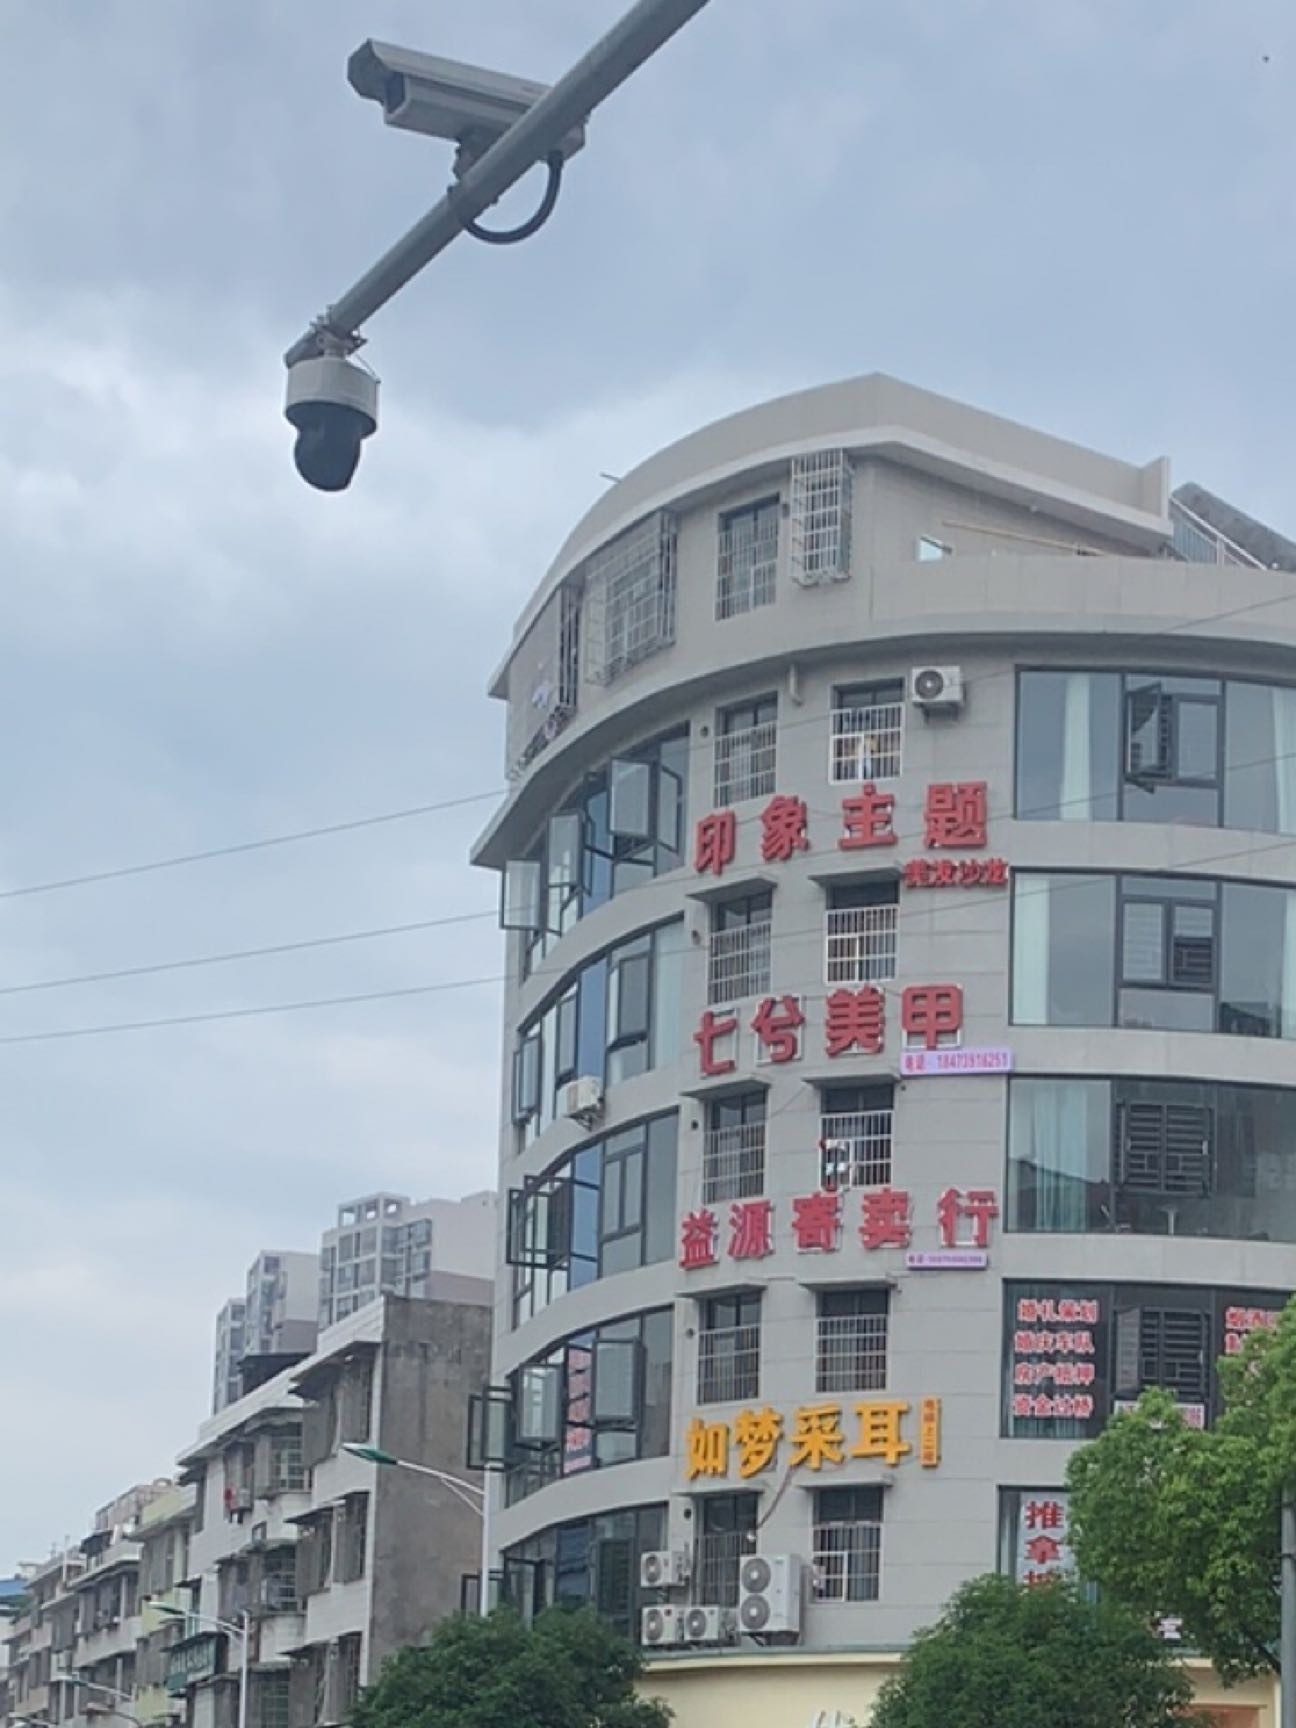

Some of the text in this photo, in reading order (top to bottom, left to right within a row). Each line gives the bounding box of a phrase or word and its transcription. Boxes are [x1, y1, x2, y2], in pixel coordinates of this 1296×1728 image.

[694, 781, 988, 875] 印象主题
[693, 983, 964, 1076] 七兮美甲
[679, 1187, 999, 1270] 益源寄卖行
[686, 1402, 913, 1481] 如梦采耳
